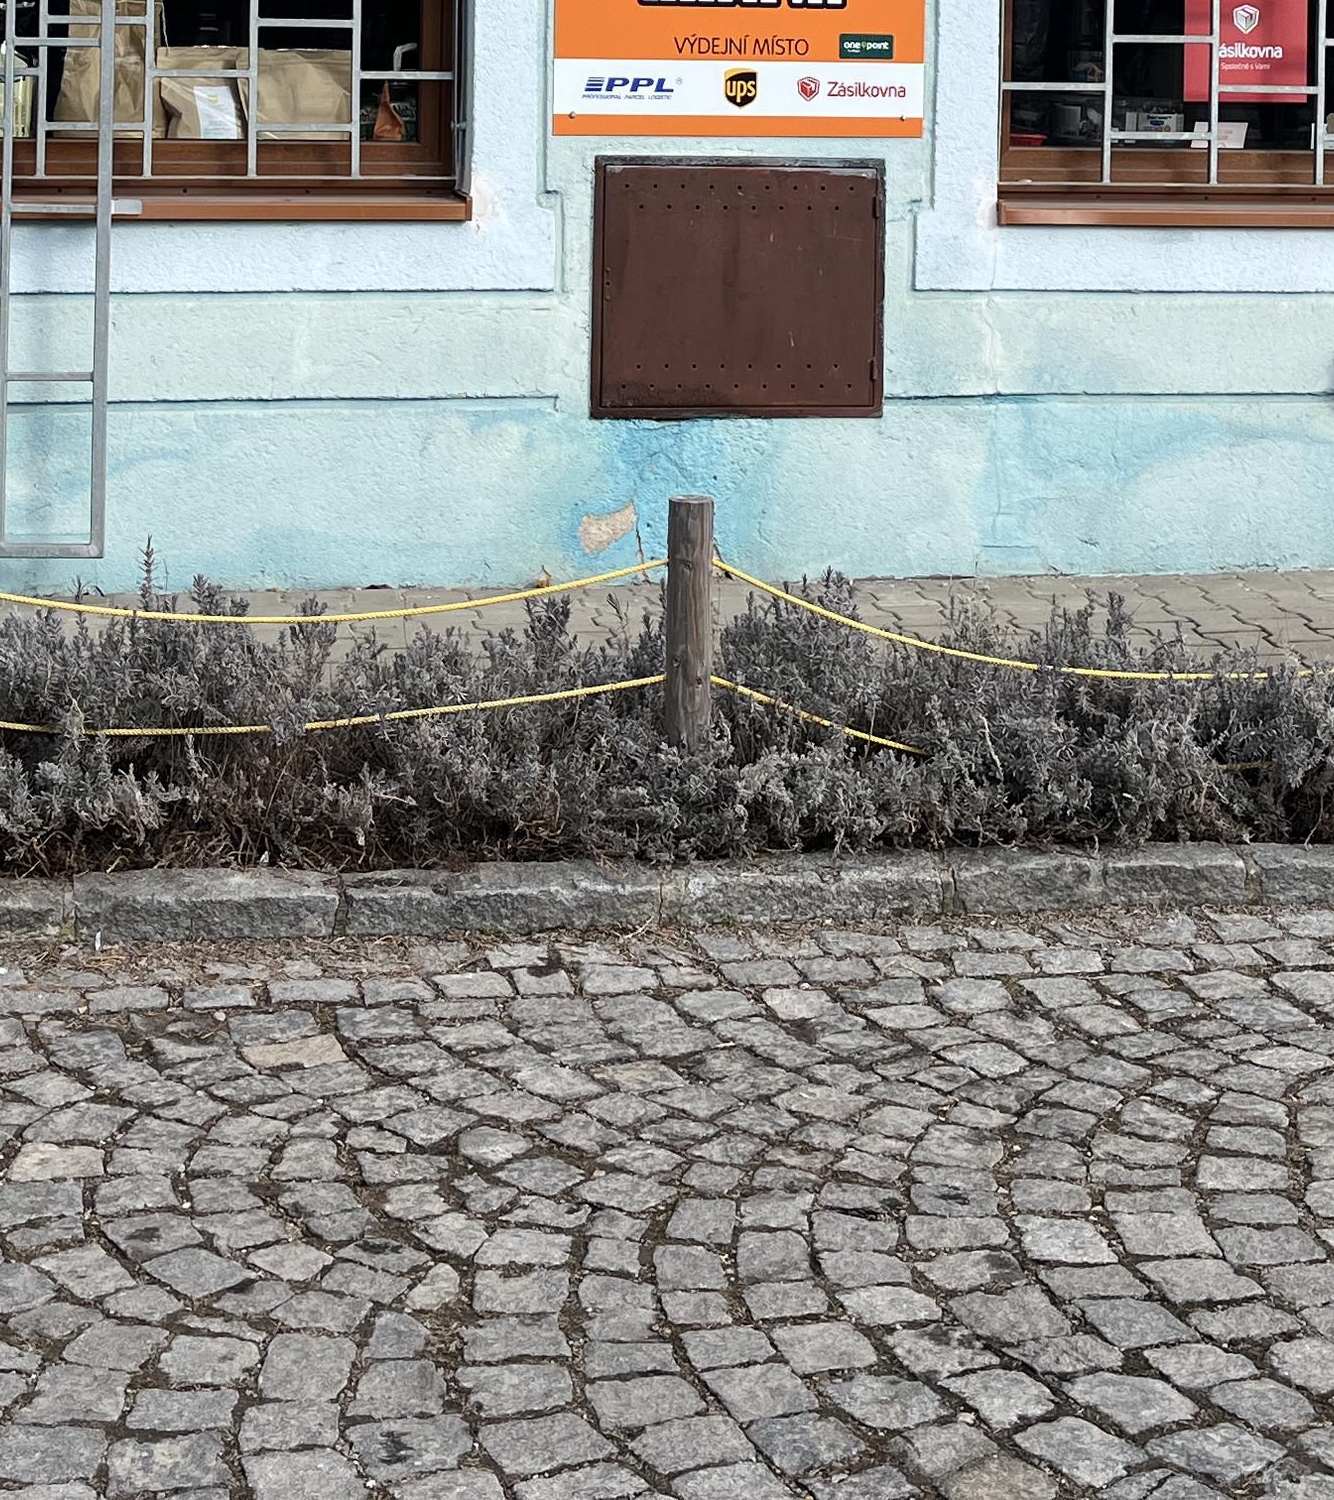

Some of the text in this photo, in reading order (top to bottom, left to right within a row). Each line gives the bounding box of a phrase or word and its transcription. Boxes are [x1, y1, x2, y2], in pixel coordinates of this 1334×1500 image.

[674, 33, 809, 56] VÝDEJNÍ MÍSTO
[1219, 42, 1283, 59] ásilkovna
[605, 77, 674, 93] PPL
[725, 78, 756, 102] ups
[827, 81, 907, 98] Zásilkovna
